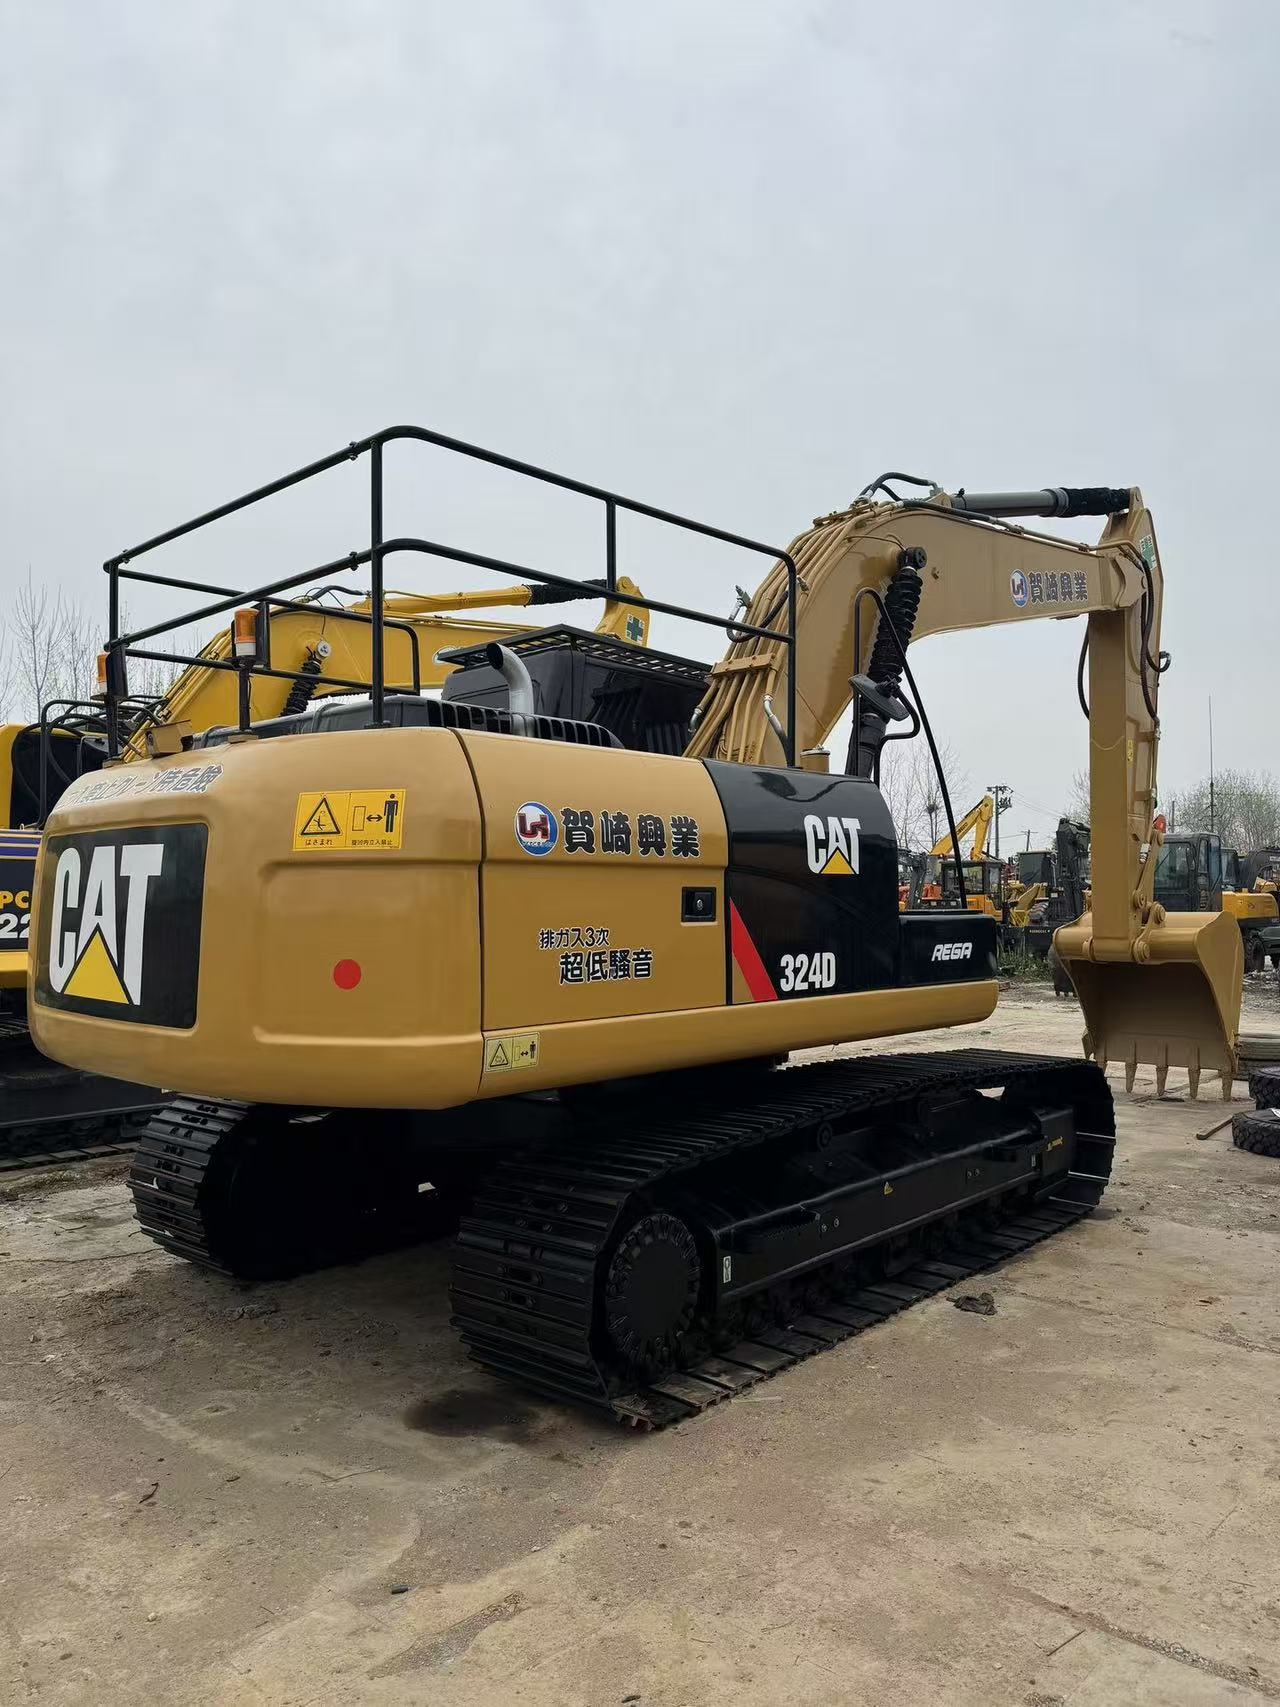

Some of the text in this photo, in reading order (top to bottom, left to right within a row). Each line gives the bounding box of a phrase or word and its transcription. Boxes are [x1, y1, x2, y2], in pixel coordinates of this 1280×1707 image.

[305, 838, 334, 847] はさまれ
[804, 814, 861, 875] CAT
[49, 843, 165, 1006] CAT
[539, 926, 610, 949] 排ガス3次
[559, 948, 653, 985] 超低騒音
[780, 952, 836, 992] 324D
